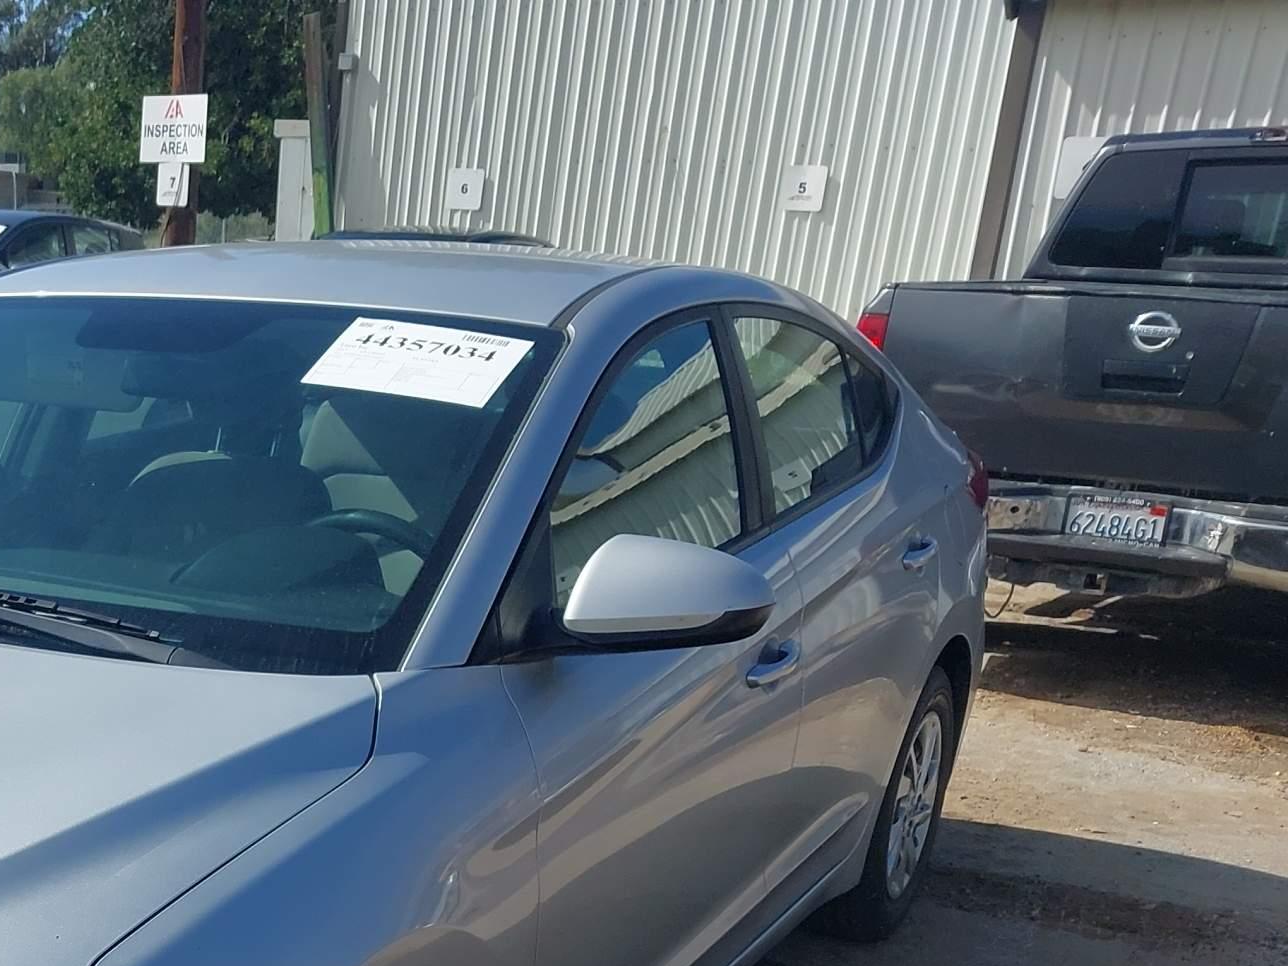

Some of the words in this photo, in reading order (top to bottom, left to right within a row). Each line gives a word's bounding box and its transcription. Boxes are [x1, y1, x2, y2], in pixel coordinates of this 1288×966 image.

[144, 123, 204, 138] INSPECTION
[160, 141, 189, 155] AREA
[169, 176, 176, 188] 7
[461, 183, 468, 194] 6
[798, 182, 807, 194] 5
[355, 333, 498, 362] 44357034
[1070, 510, 1159, 542] 62484G1
